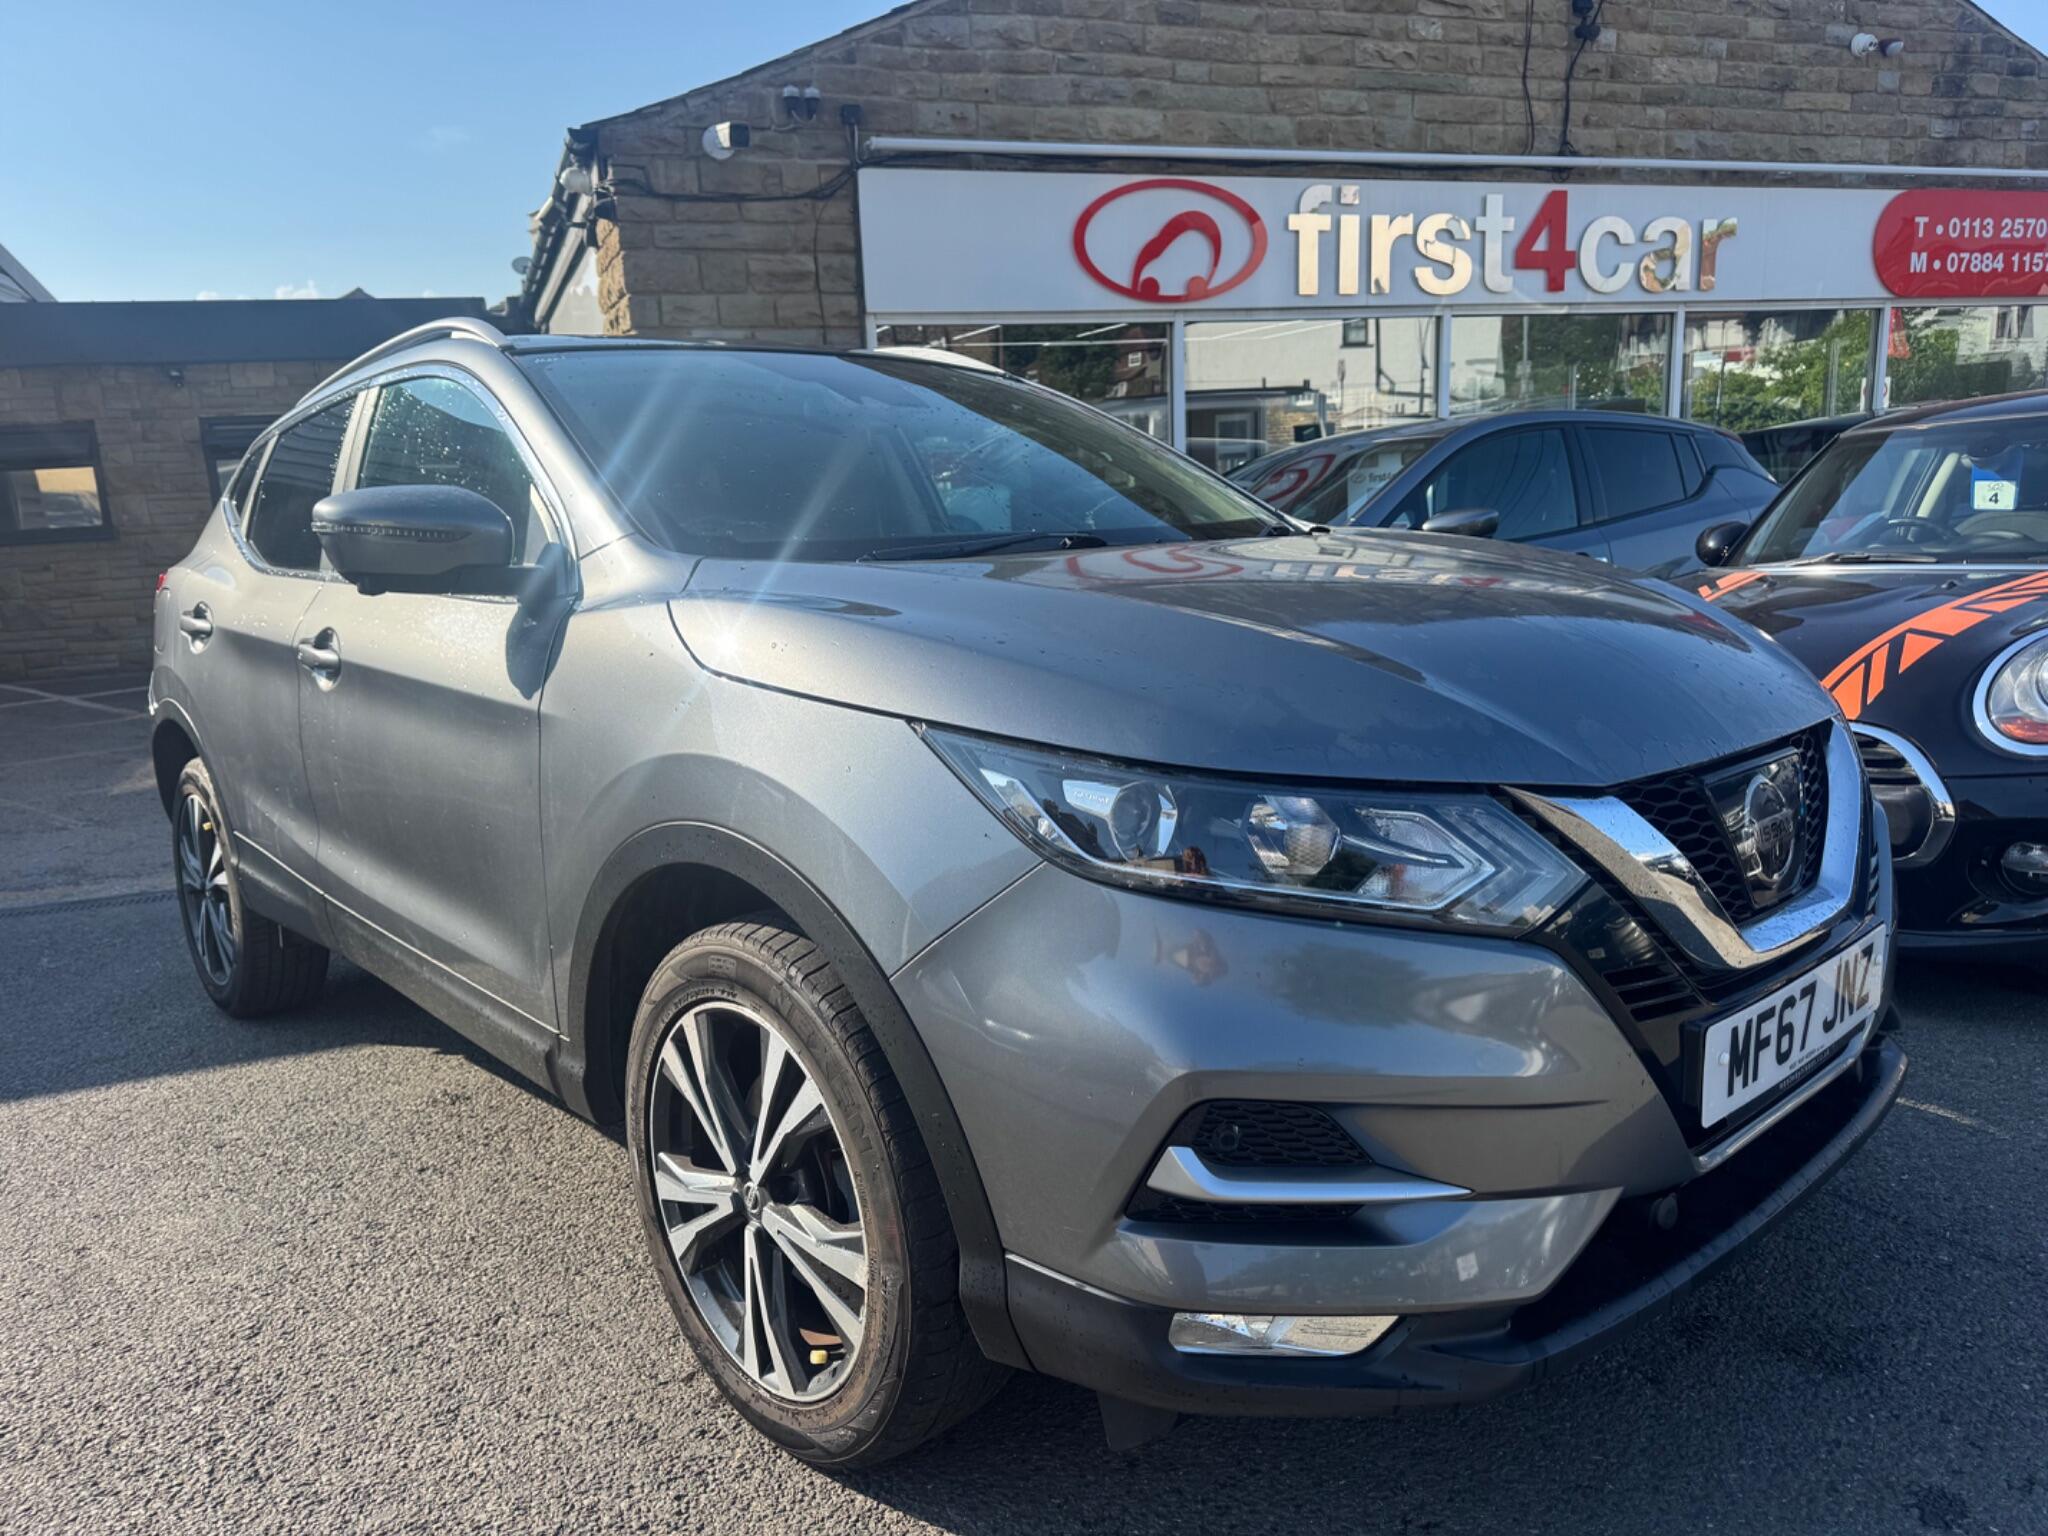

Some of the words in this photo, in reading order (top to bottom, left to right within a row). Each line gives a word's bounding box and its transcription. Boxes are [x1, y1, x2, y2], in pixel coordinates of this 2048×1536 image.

[1288, 183, 1738, 296] first4car
[1915, 216, 1929, 238] T
[1948, 217, 1995, 239] 0113
[1999, 217, 2048, 240] 2570
[1909, 252, 1928, 274] M
[1946, 252, 2005, 274] 07884
[2011, 252, 2048, 274] 115
[1988, 492, 1999, 504] 4
[1727, 979, 1817, 1098] MF67
[1822, 942, 1874, 1034] JNZ
